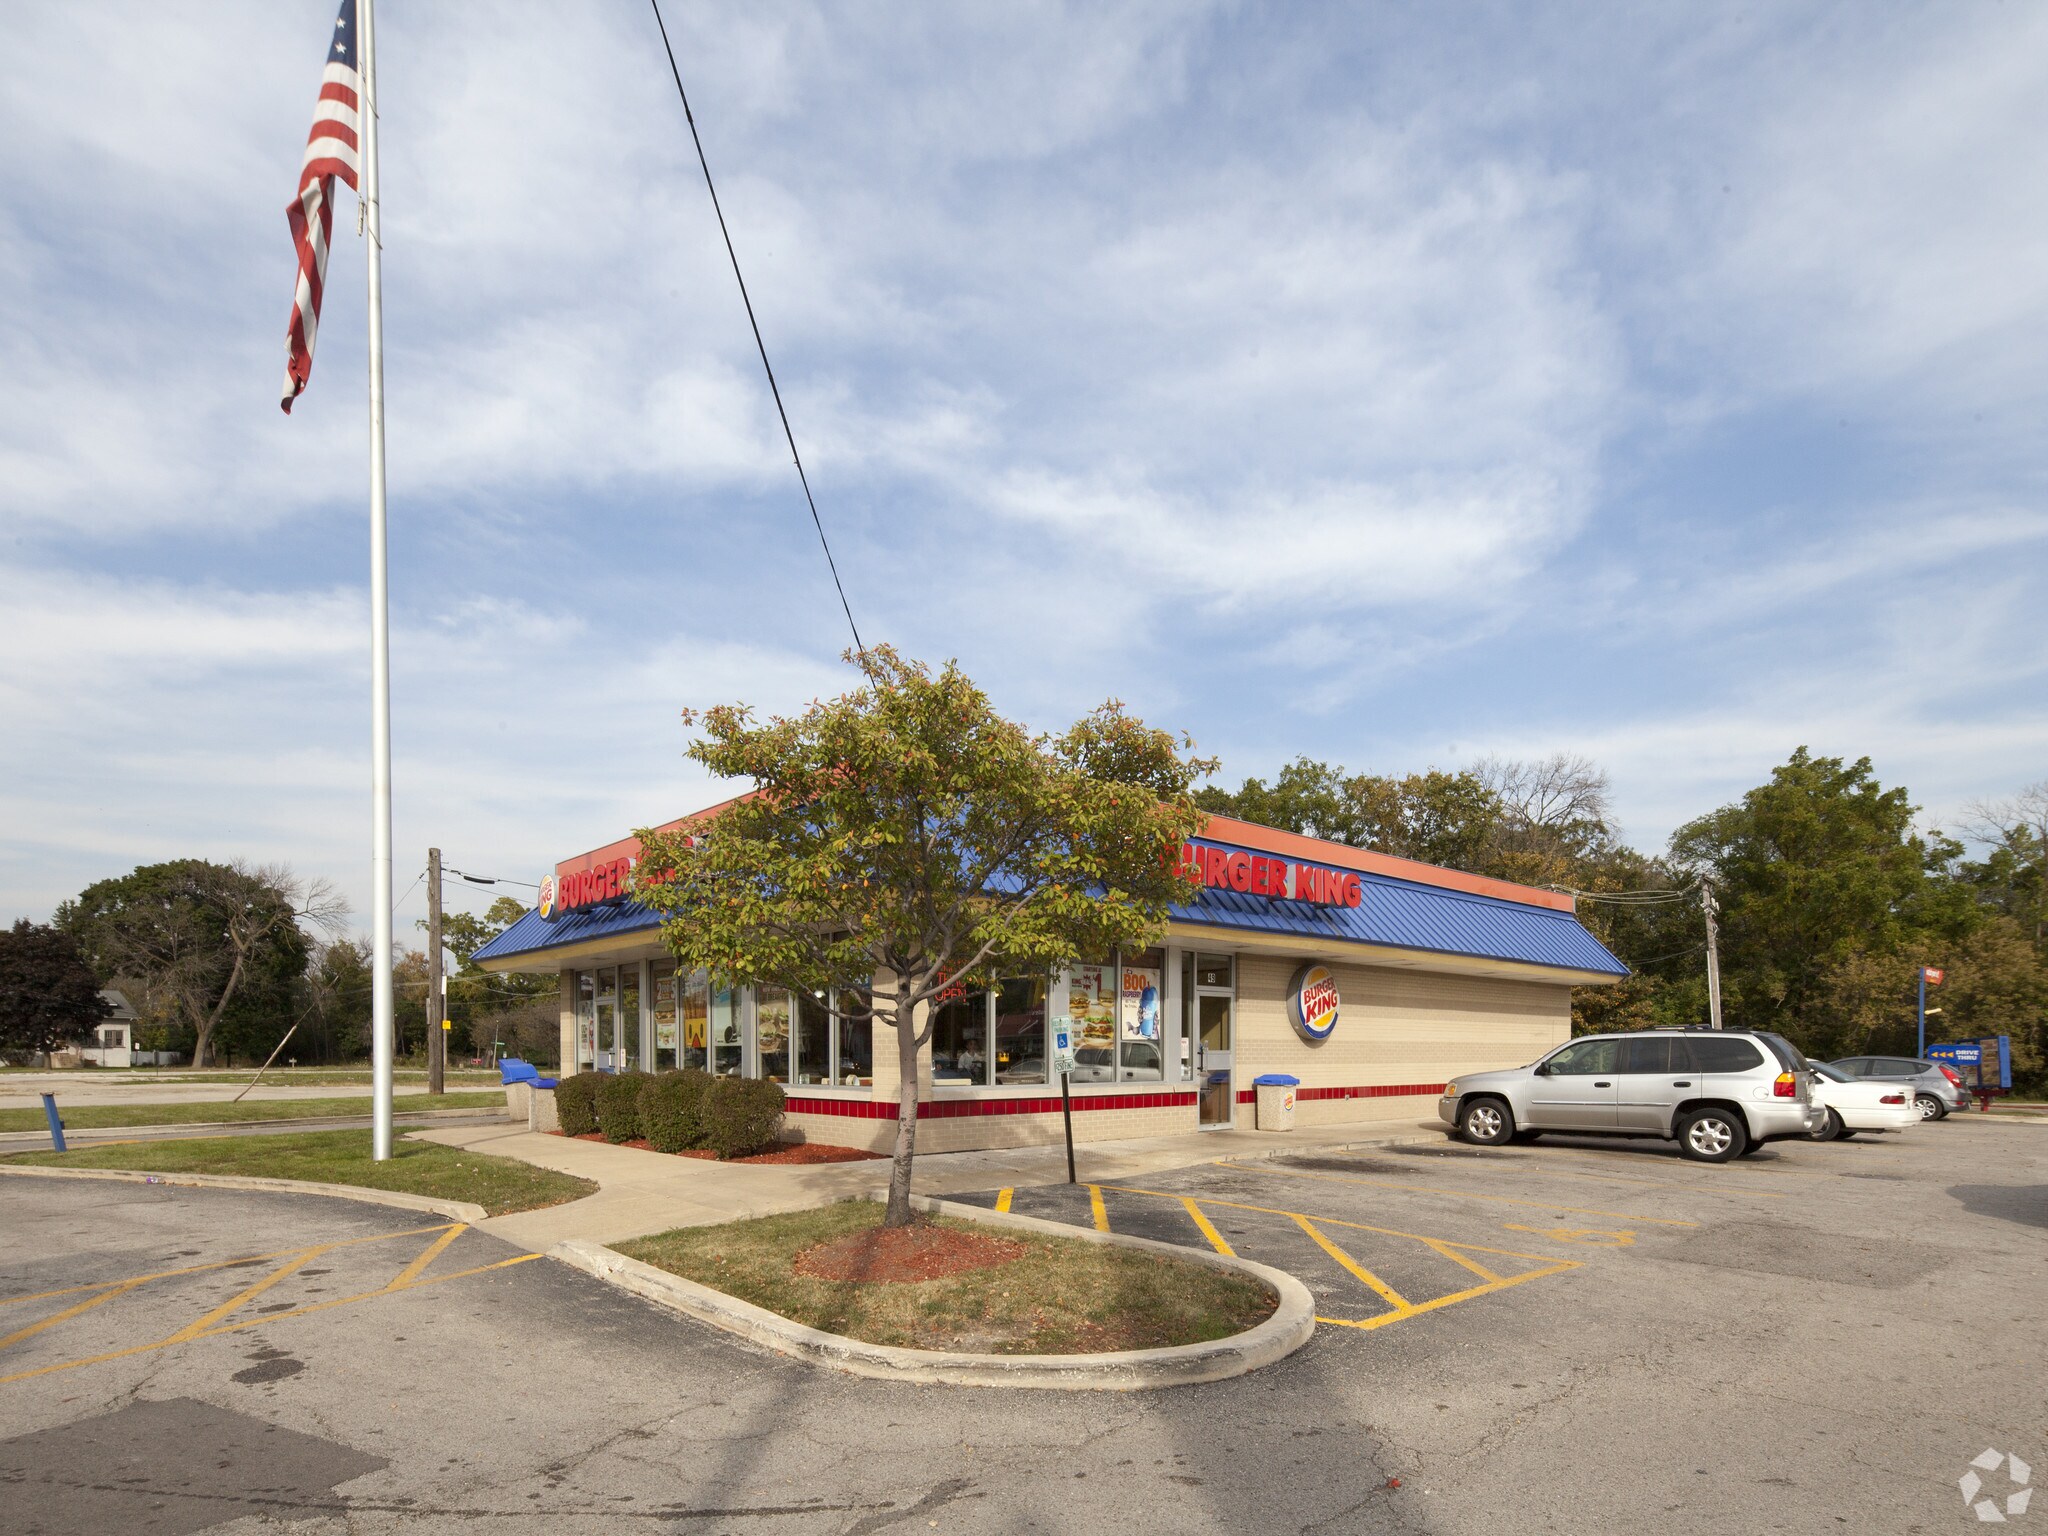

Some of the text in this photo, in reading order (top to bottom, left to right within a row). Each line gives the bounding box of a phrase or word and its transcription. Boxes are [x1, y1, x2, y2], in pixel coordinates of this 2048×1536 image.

[558, 857, 632, 911] BURGER
[1295, 863, 1361, 909] KING
[937, 971, 967, 988] THU
[1303, 976, 1336, 1006] BURGER
[1305, 989, 1338, 1024] KING
